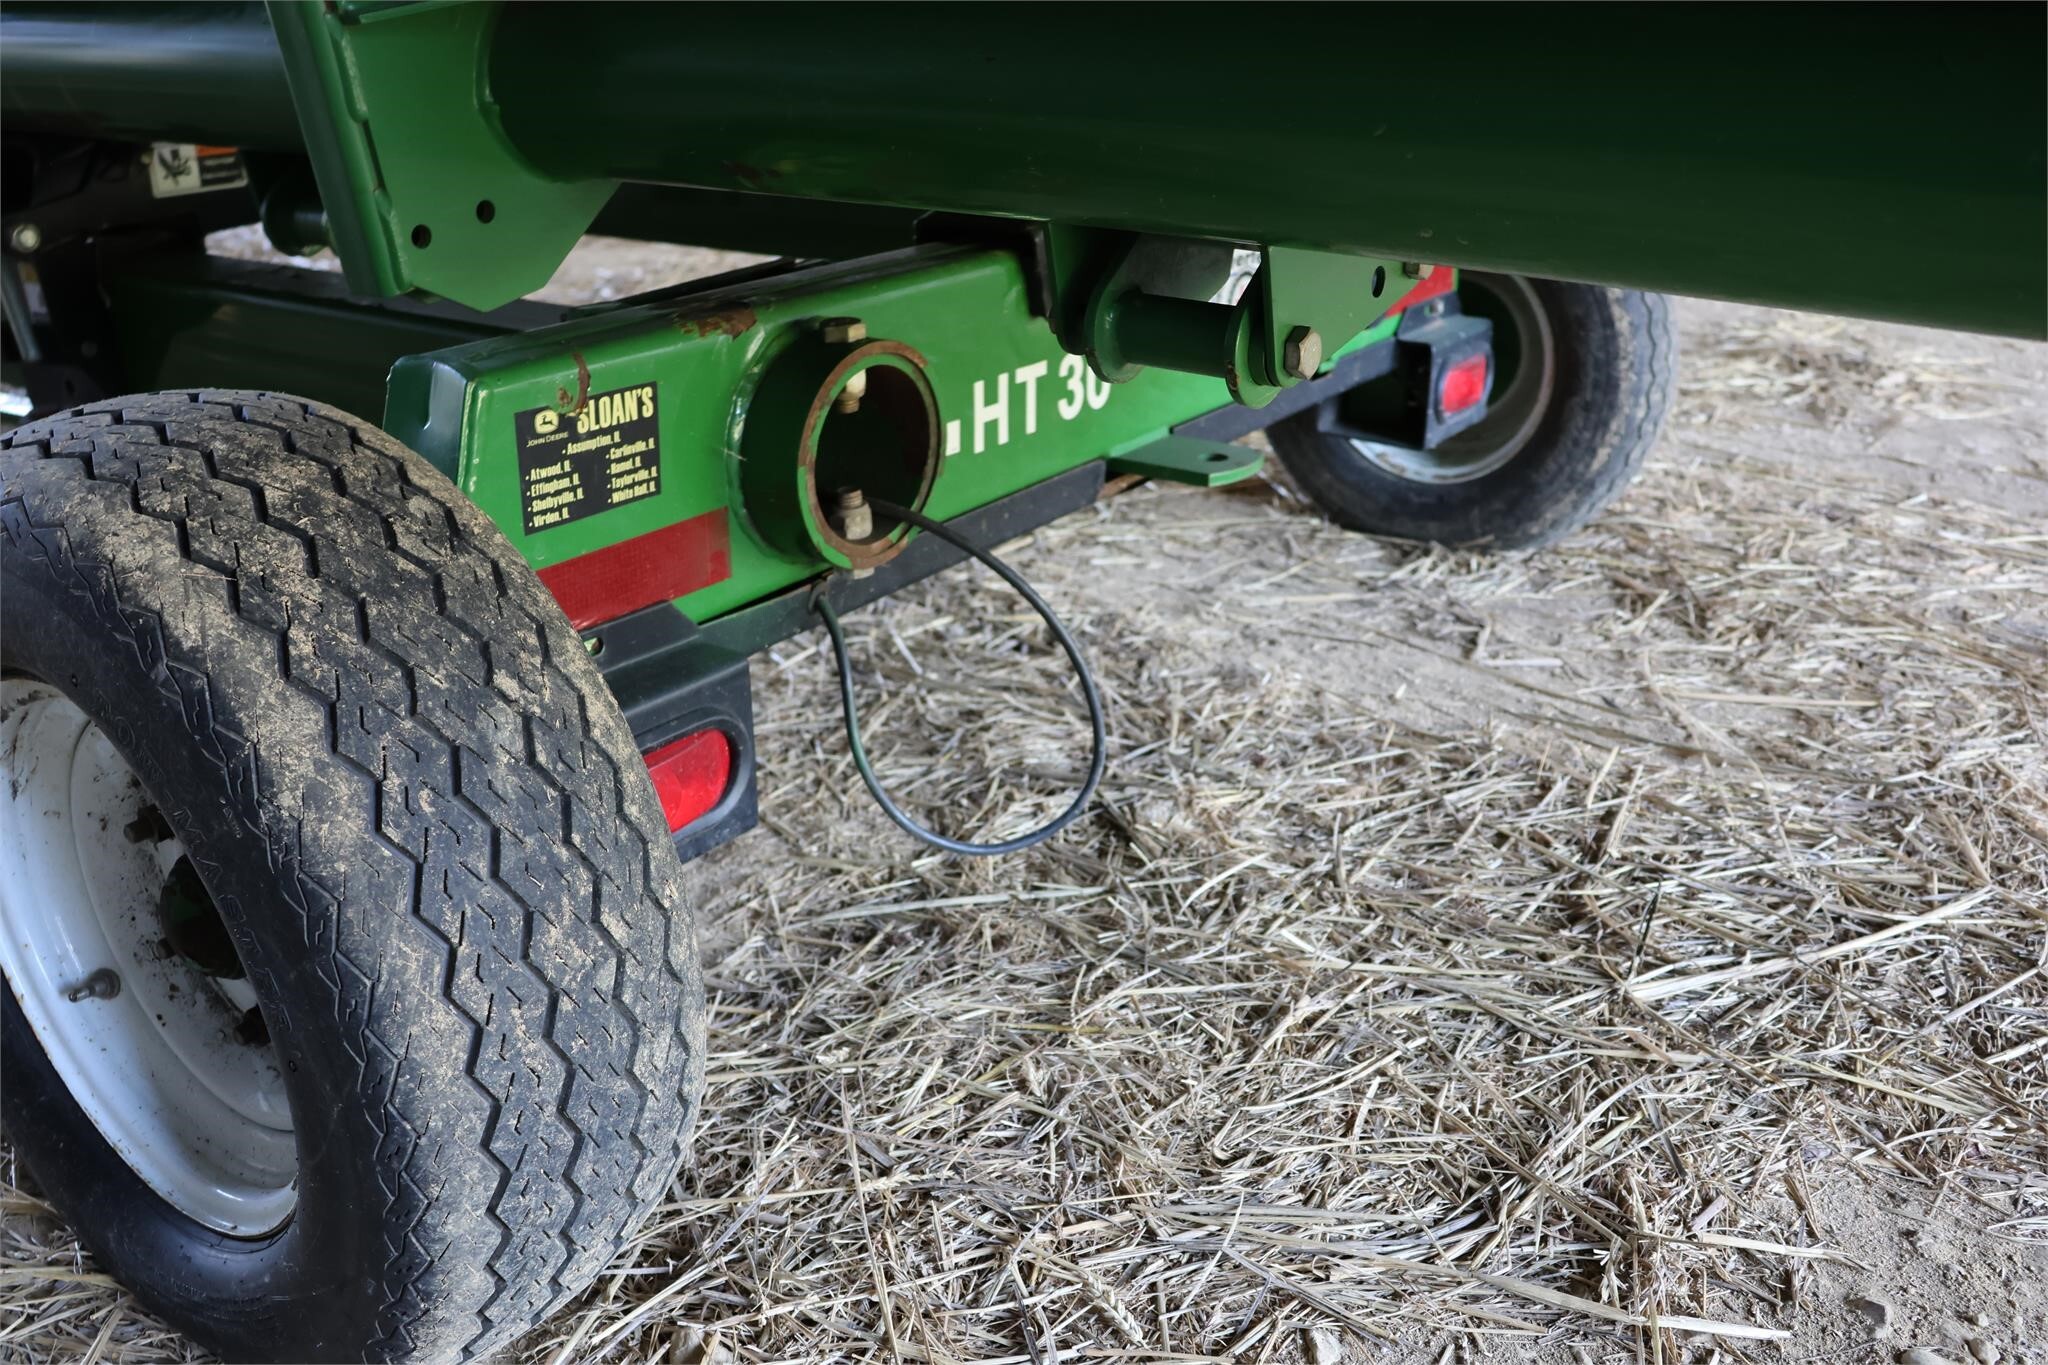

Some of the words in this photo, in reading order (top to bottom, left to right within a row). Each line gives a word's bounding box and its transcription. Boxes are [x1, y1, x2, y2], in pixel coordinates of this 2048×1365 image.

[576, 386, 654, 434] SLOAN'S
[973, 359, 1048, 454] HT
[1057, 353, 1112, 421] 30
[526, 437, 545, 447] JOHN
[546, 431, 569, 442] DEERE
